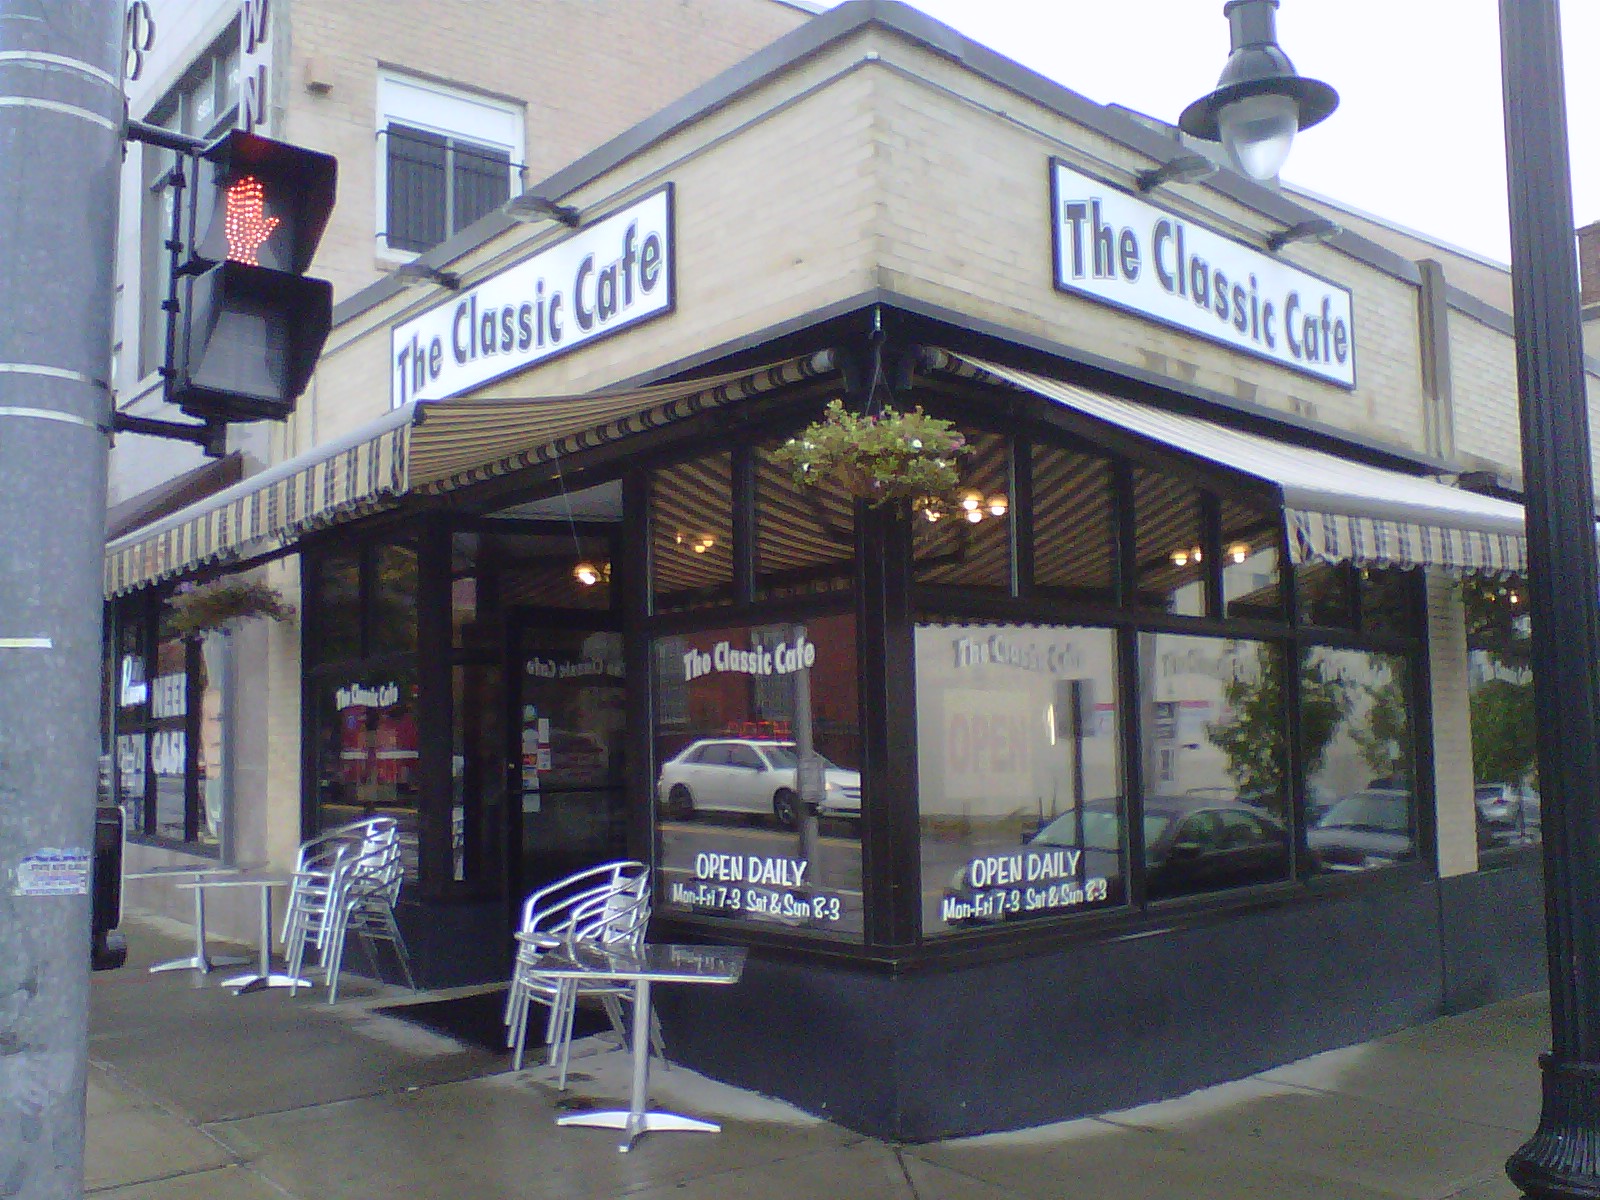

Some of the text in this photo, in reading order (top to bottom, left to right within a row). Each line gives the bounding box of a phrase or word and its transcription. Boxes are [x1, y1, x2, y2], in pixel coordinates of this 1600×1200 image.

[1064, 197, 1348, 365] The Classic Cafe
[397, 217, 664, 404] The Classic Cafe
[683, 635, 815, 681] The Classic Cafe
[696, 852, 808, 887] OPEN DAILY
[971, 850, 1081, 888] OPEN DAILY
[718, 887, 741, 910] 7-3
[745, 890, 768, 913] Sat
[769, 893, 782, 914] &
[783, 893, 810, 917] Sun
[813, 896, 840, 921] 8-3
[996, 889, 1020, 914] 7-3
[1025, 887, 1045, 911] Sat
[1048, 885, 1059, 907] &
[1060, 883, 1084, 905] Sun
